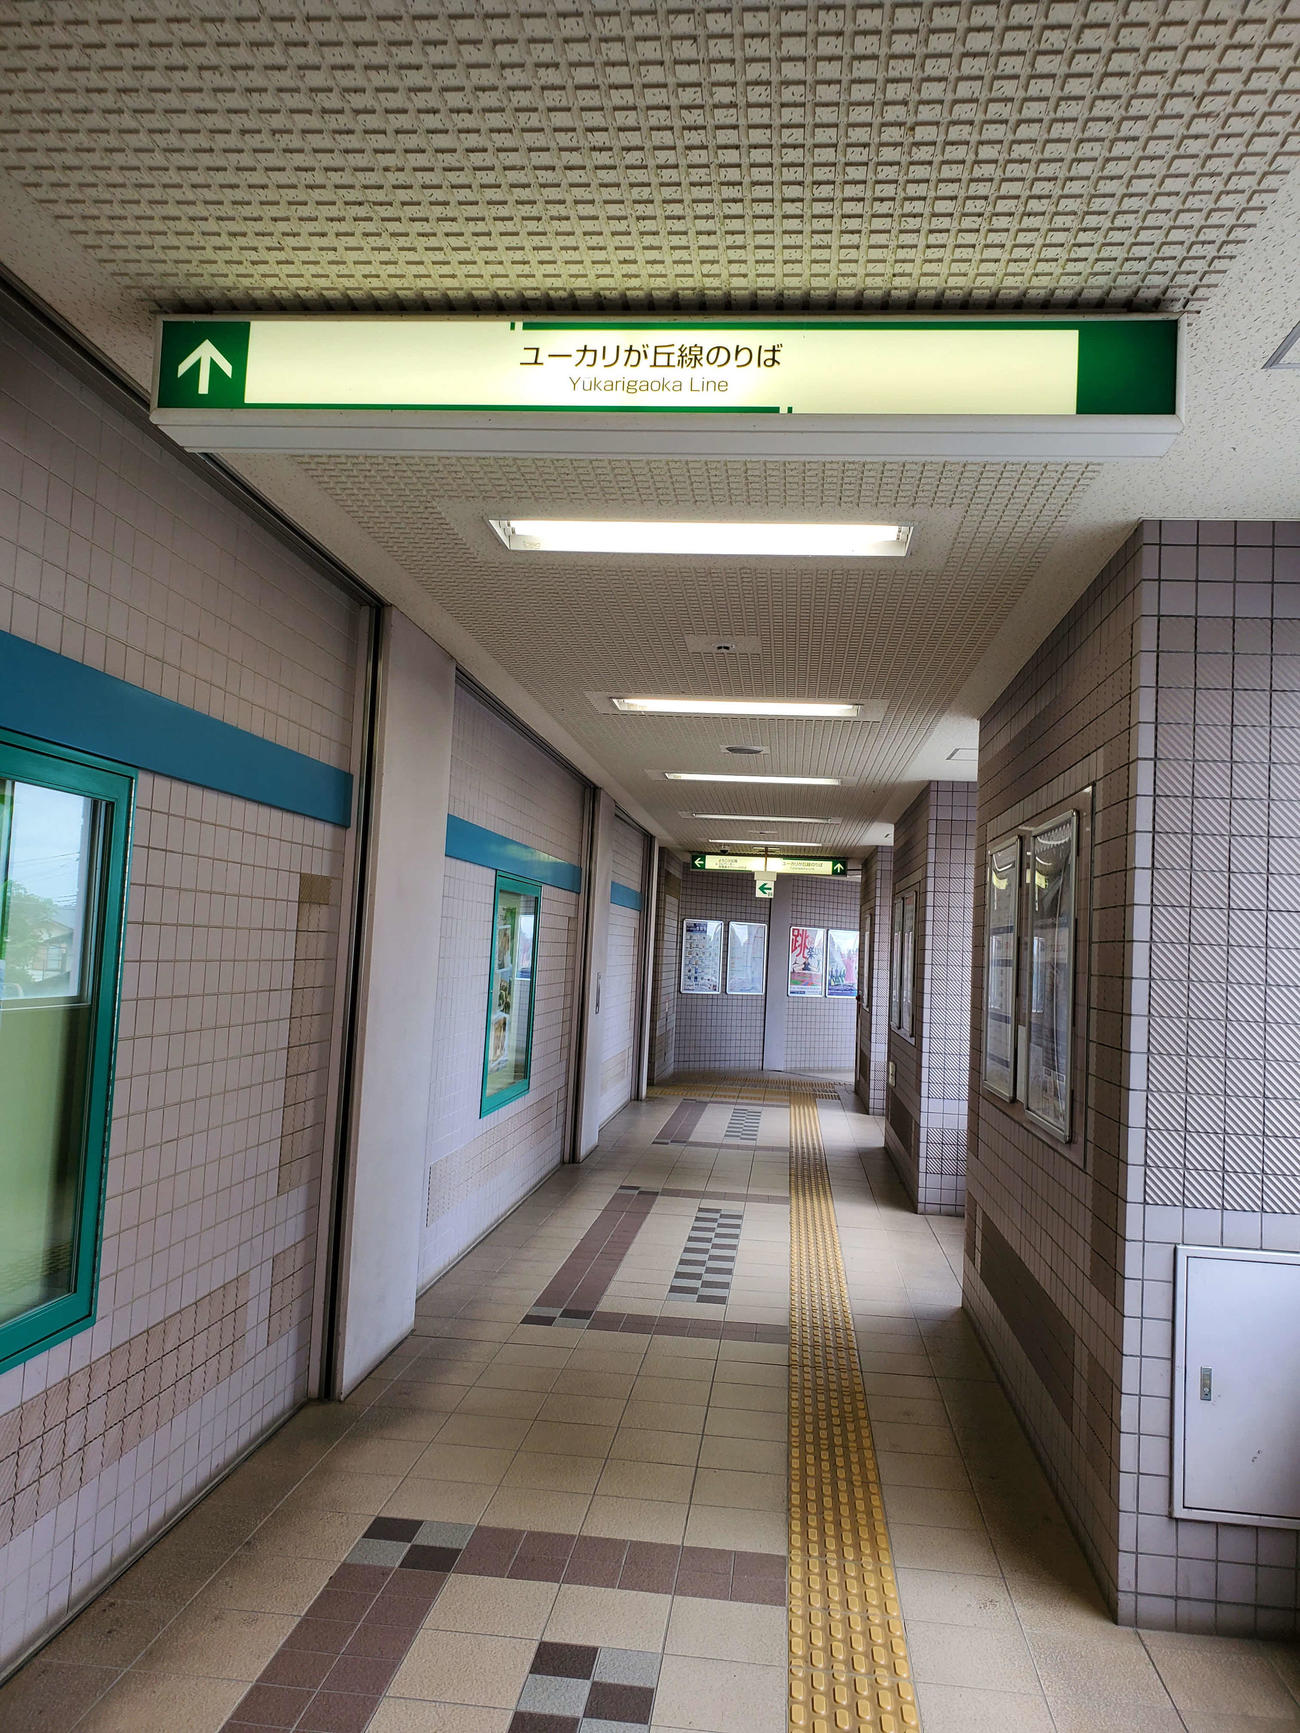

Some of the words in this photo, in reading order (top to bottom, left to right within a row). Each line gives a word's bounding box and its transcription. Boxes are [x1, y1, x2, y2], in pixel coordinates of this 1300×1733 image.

[520, 343, 783, 369] ユーカリが丘線のりば
[691, 376, 729, 393] Line
